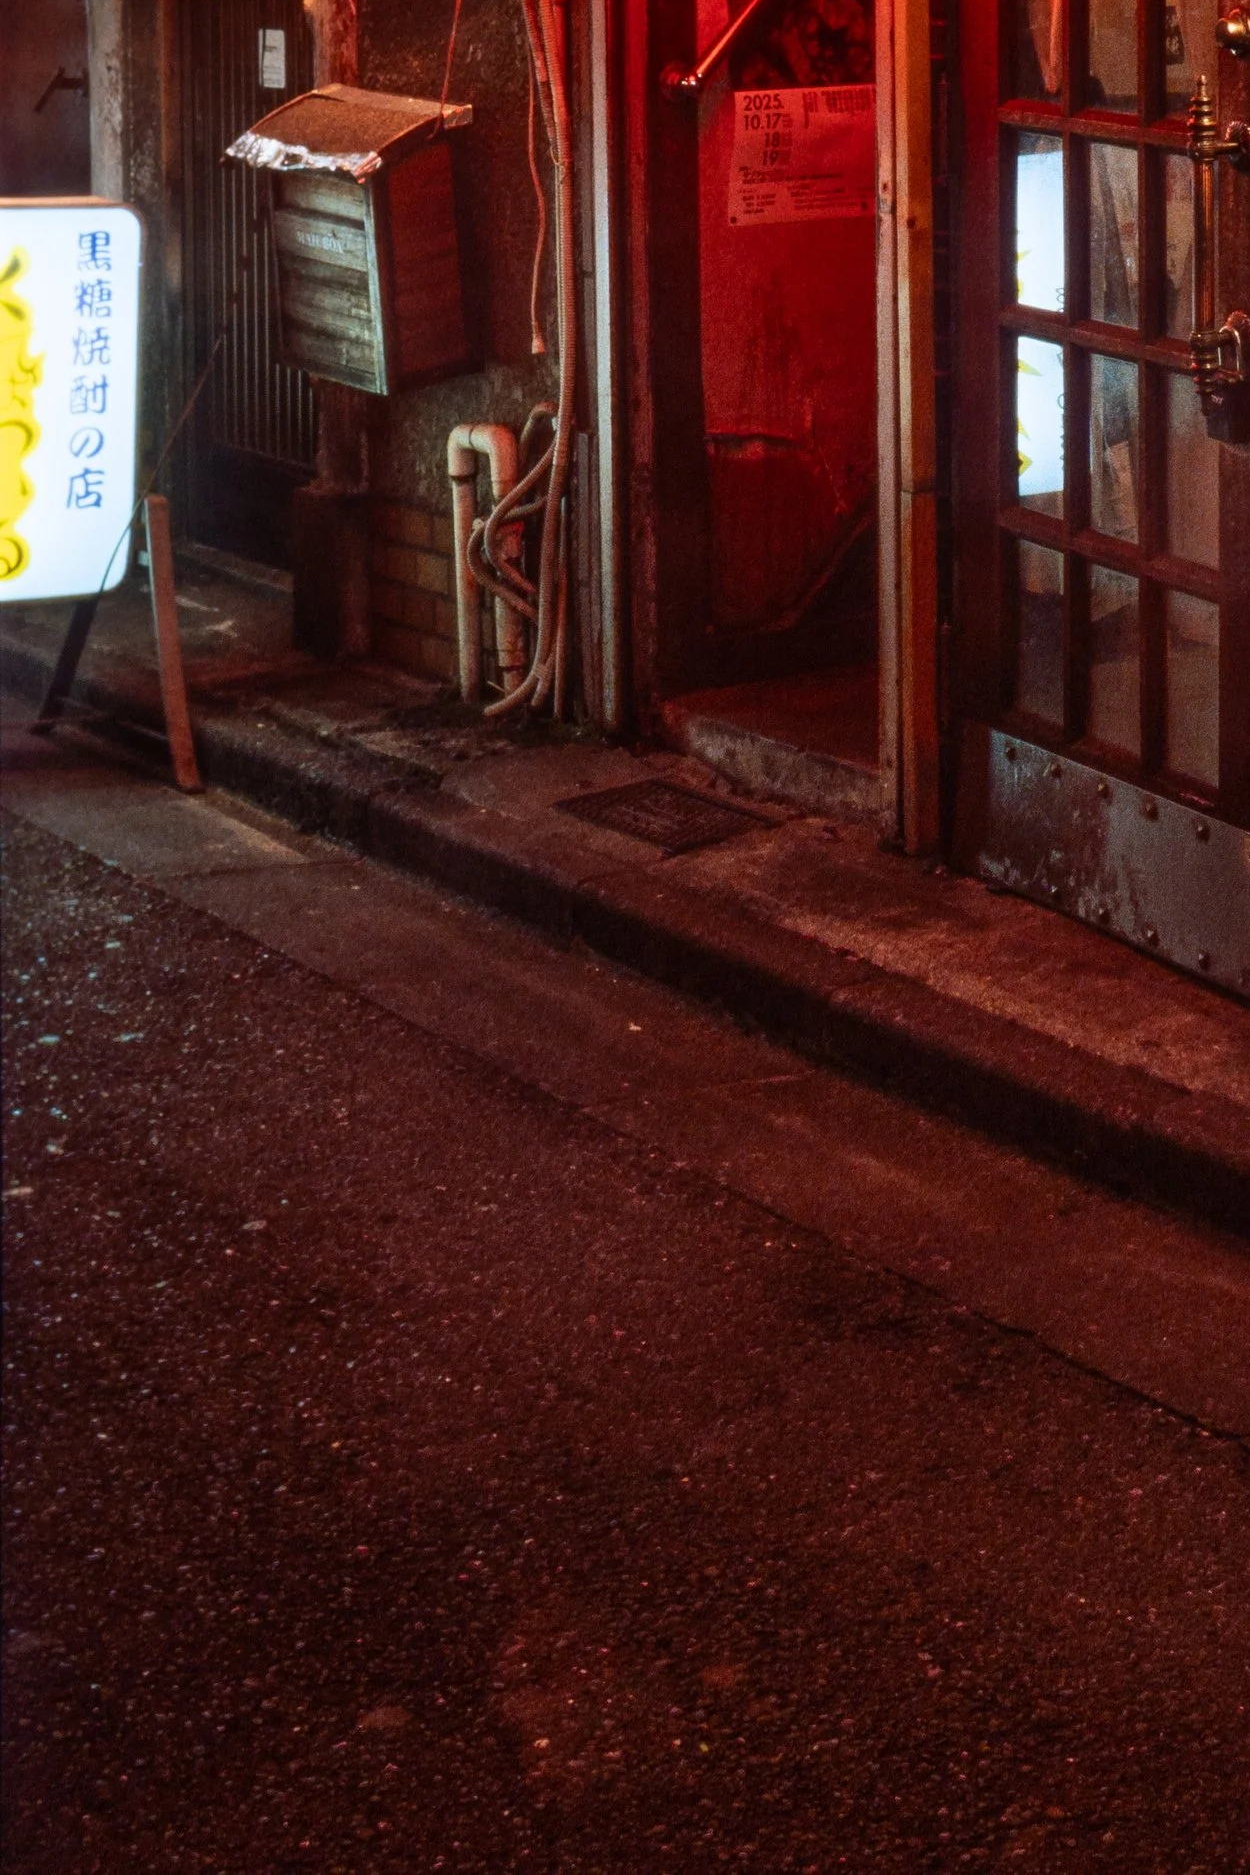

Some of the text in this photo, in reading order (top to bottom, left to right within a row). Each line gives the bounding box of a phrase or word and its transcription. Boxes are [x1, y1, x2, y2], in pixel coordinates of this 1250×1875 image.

[764, 131, 781, 148] 18
[66, 230, 112, 511] 黒糖焼酎の店
